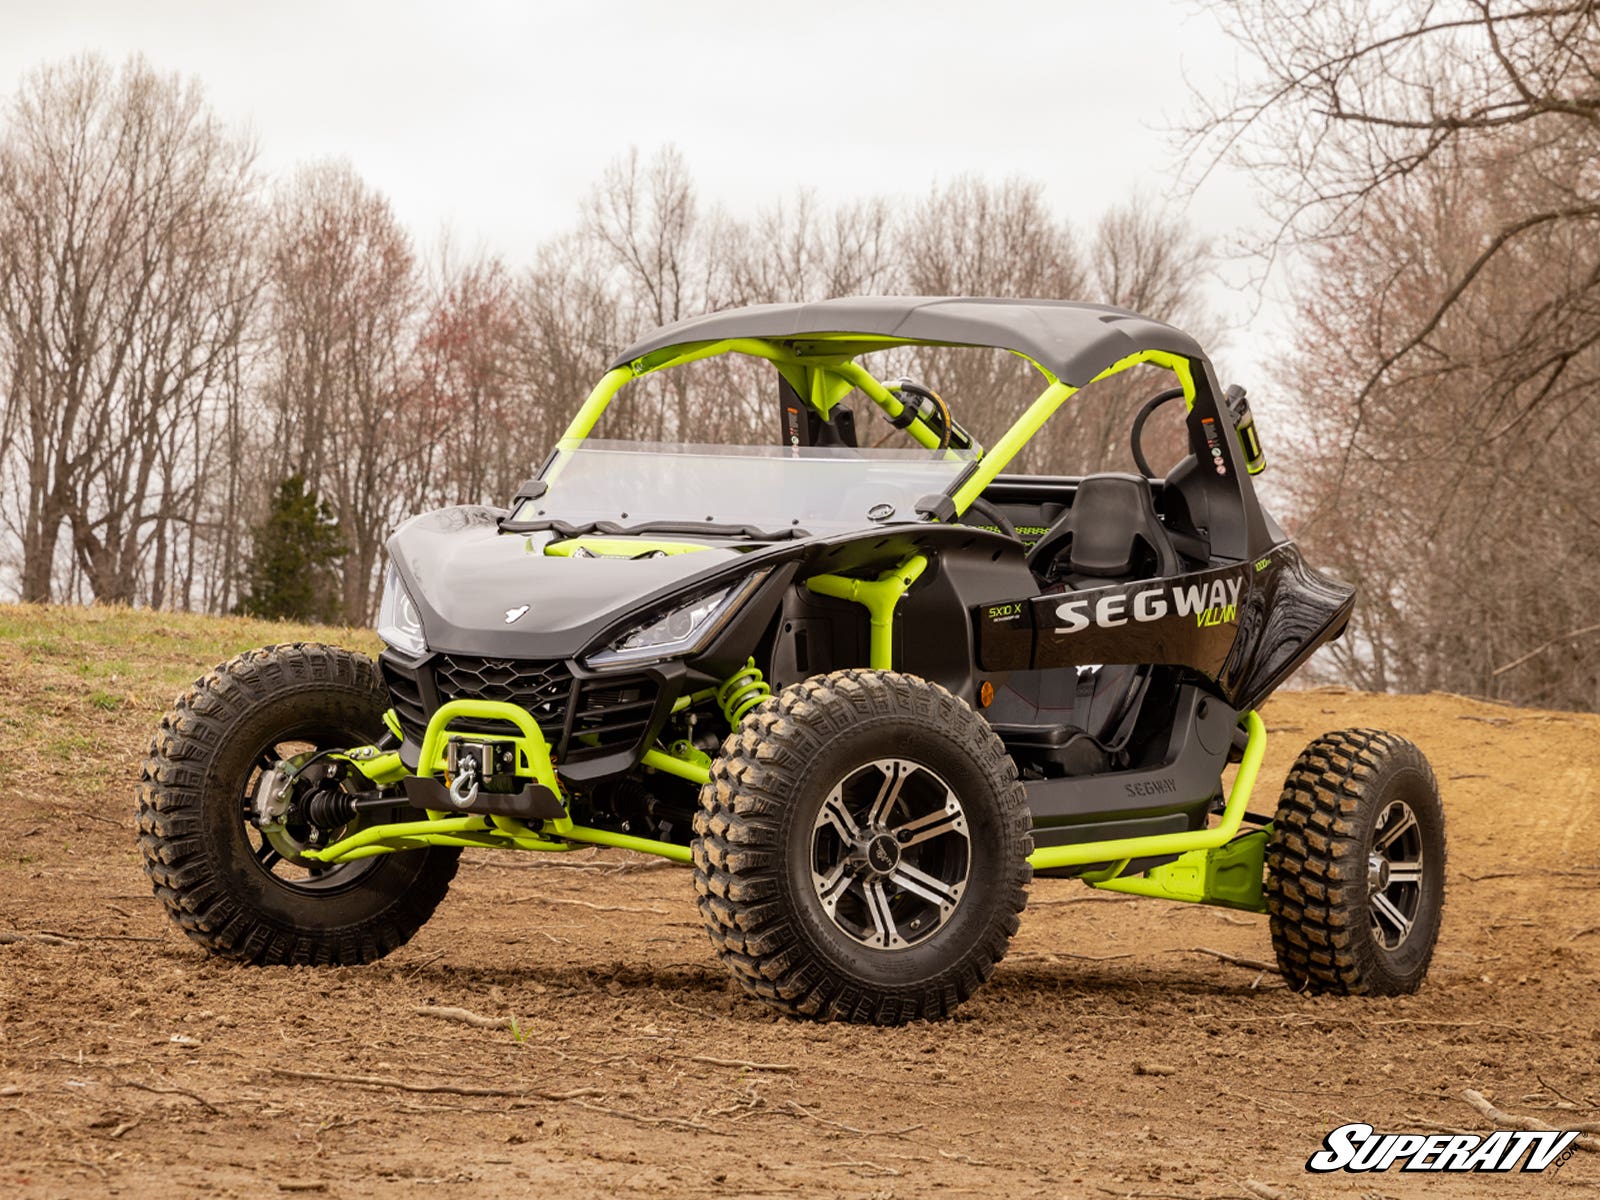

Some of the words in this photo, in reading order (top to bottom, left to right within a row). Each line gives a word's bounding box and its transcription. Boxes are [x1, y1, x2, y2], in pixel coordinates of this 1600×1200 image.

[1014, 602, 1022, 614] X
[1054, 576, 1243, 635] SEGWAY
[1196, 603, 1238, 628] VILLAIN
[1124, 778, 1177, 798] SEGWAY
